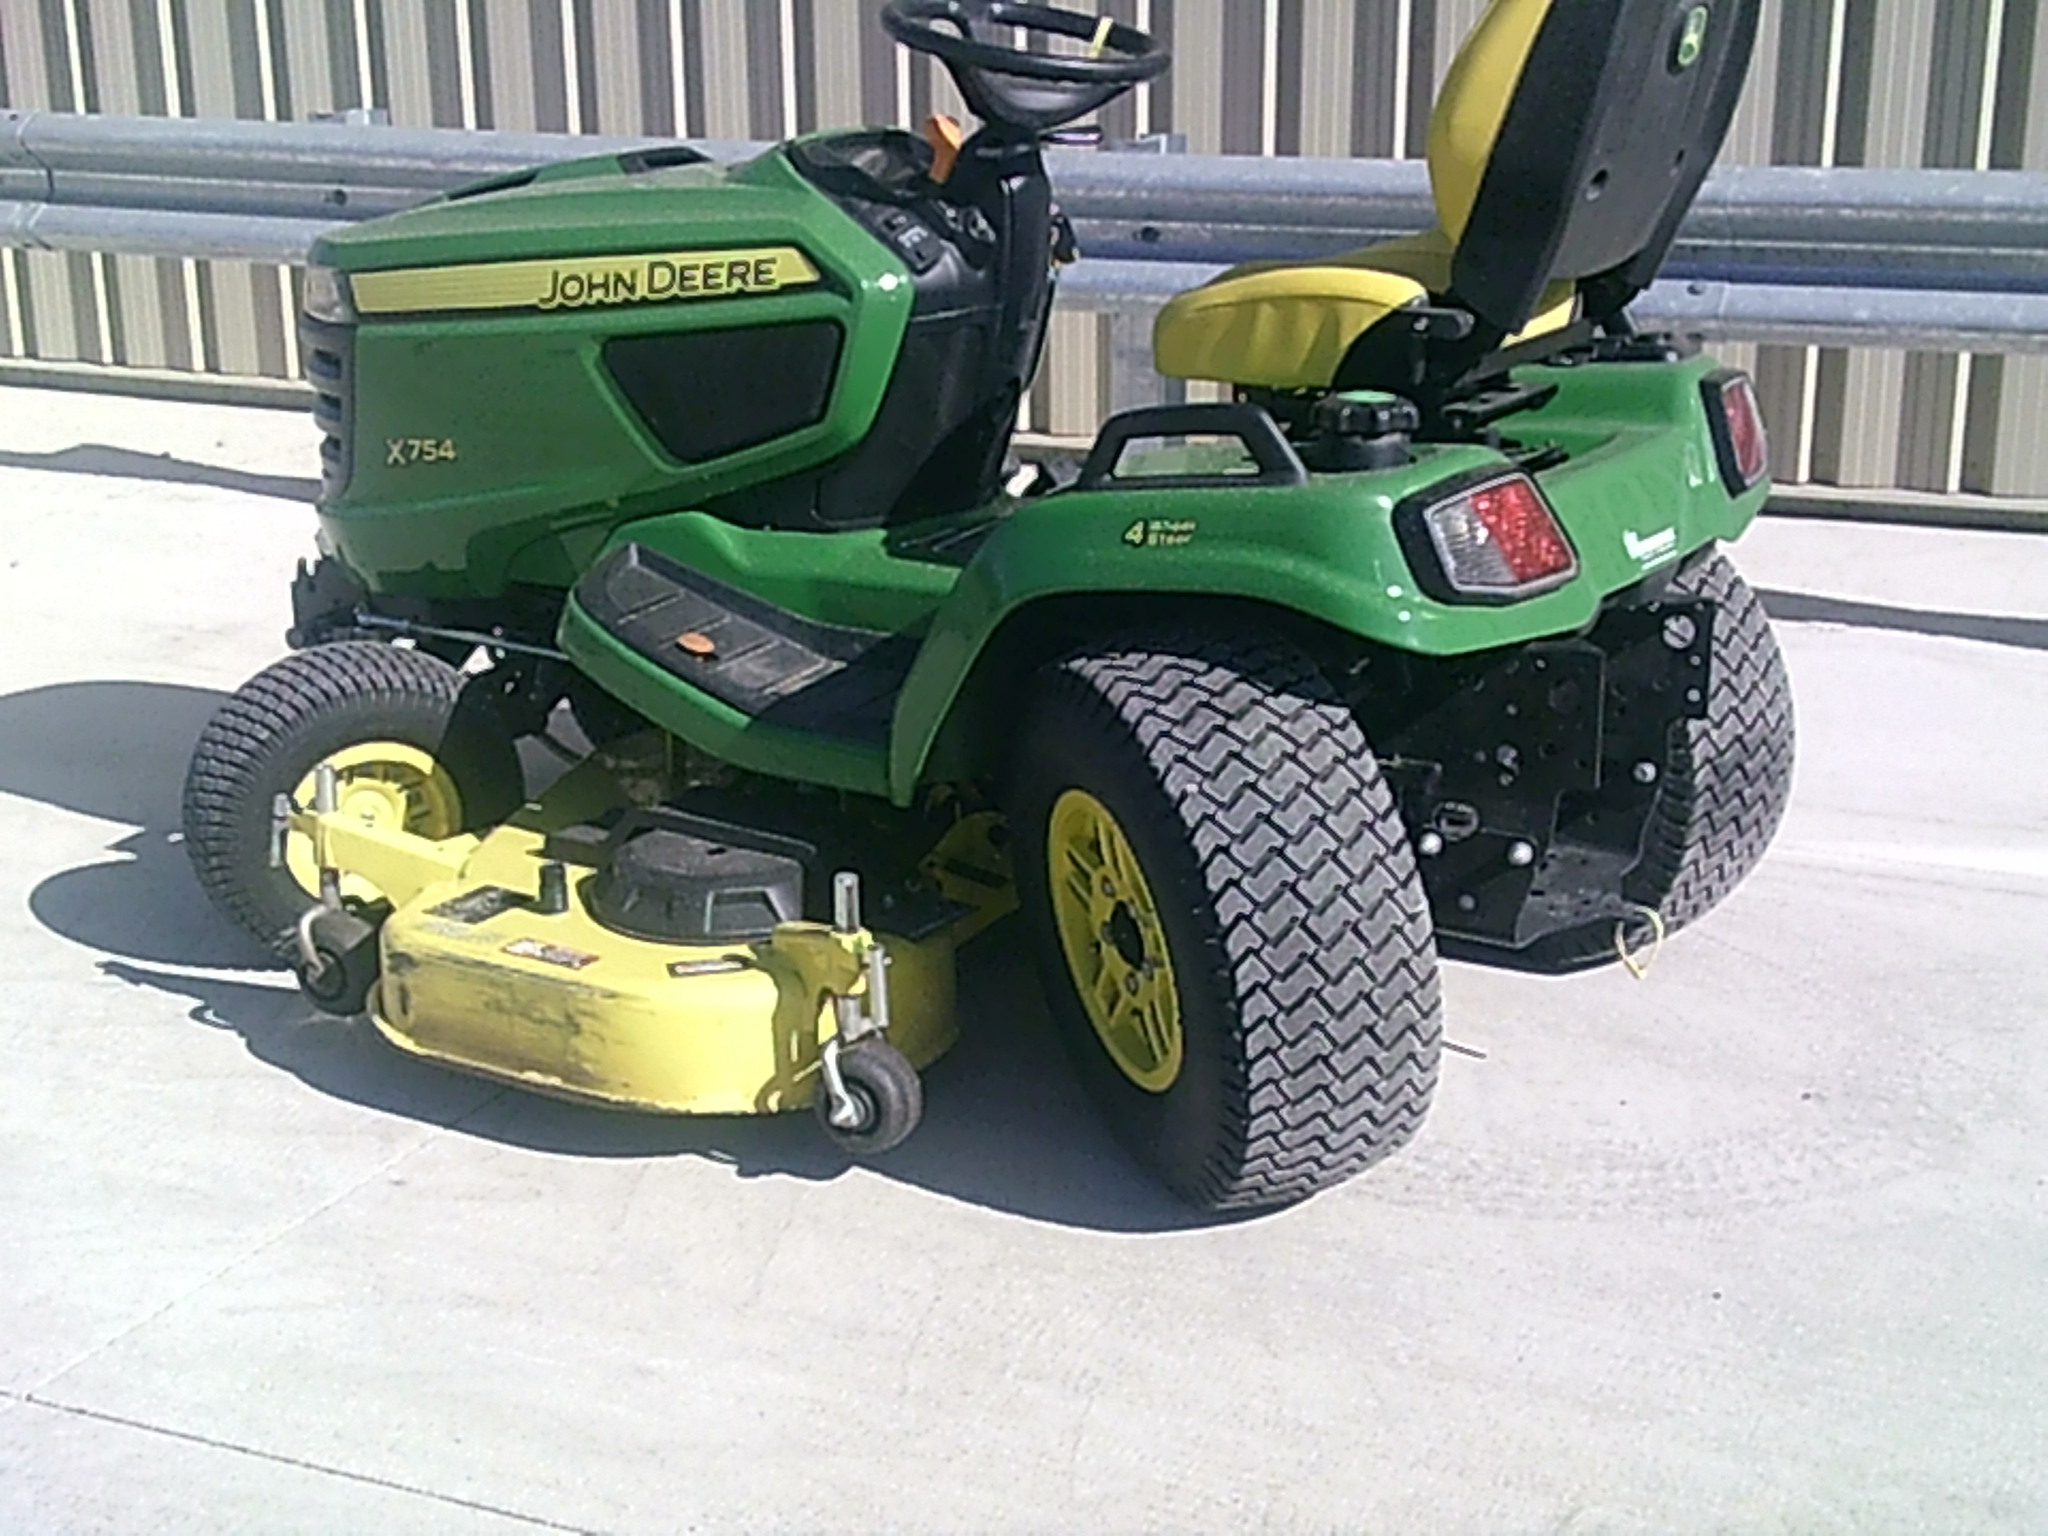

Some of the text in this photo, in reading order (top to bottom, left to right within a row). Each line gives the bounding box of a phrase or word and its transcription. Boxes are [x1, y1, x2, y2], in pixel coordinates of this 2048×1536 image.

[539, 258, 778, 305] JOHN DEERE
[386, 437, 457, 466] X754
[1124, 518, 1146, 546] 4
